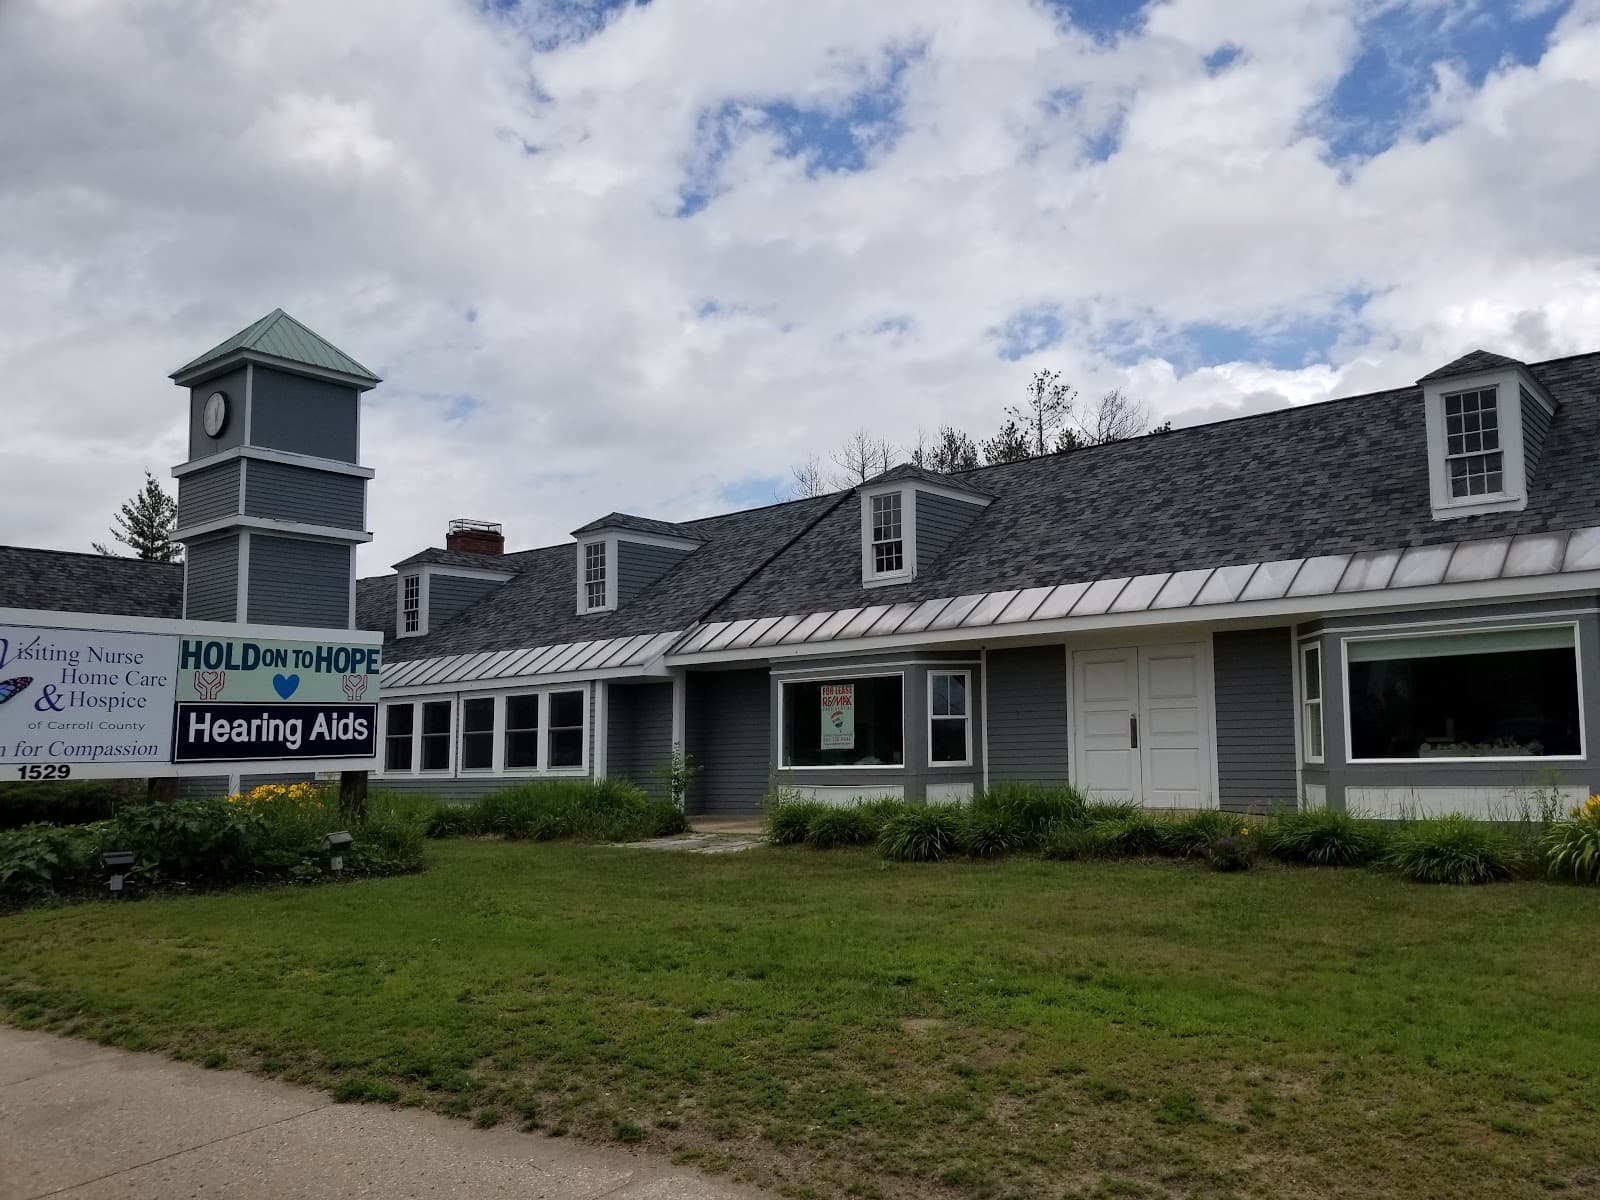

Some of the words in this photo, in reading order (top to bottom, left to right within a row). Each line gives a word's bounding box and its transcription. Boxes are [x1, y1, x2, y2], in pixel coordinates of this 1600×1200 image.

[87, 646, 144, 665] Nurse
[181, 640, 261, 671] HOLD
[262, 648, 288, 668] ON
[292, 649, 314, 669] TO
[315, 646, 380, 674] HOPE
[61, 668, 119, 685] Home
[125, 670, 168, 687] Care
[34, 684, 65, 711] &
[69, 691, 147, 712] Hospice
[822, 687, 834, 696] FOR
[822, 695, 852, 707] RE/MAX
[28, 721, 43, 730] of
[47, 721, 94, 730] Carroll
[98, 721, 146, 732] County
[188, 712, 303, 750] Hearing
[309, 712, 369, 741] Aids
[14, 740, 43, 757] for
[49, 740, 158, 761] Compassion
[17, 764, 71, 780] 1529
